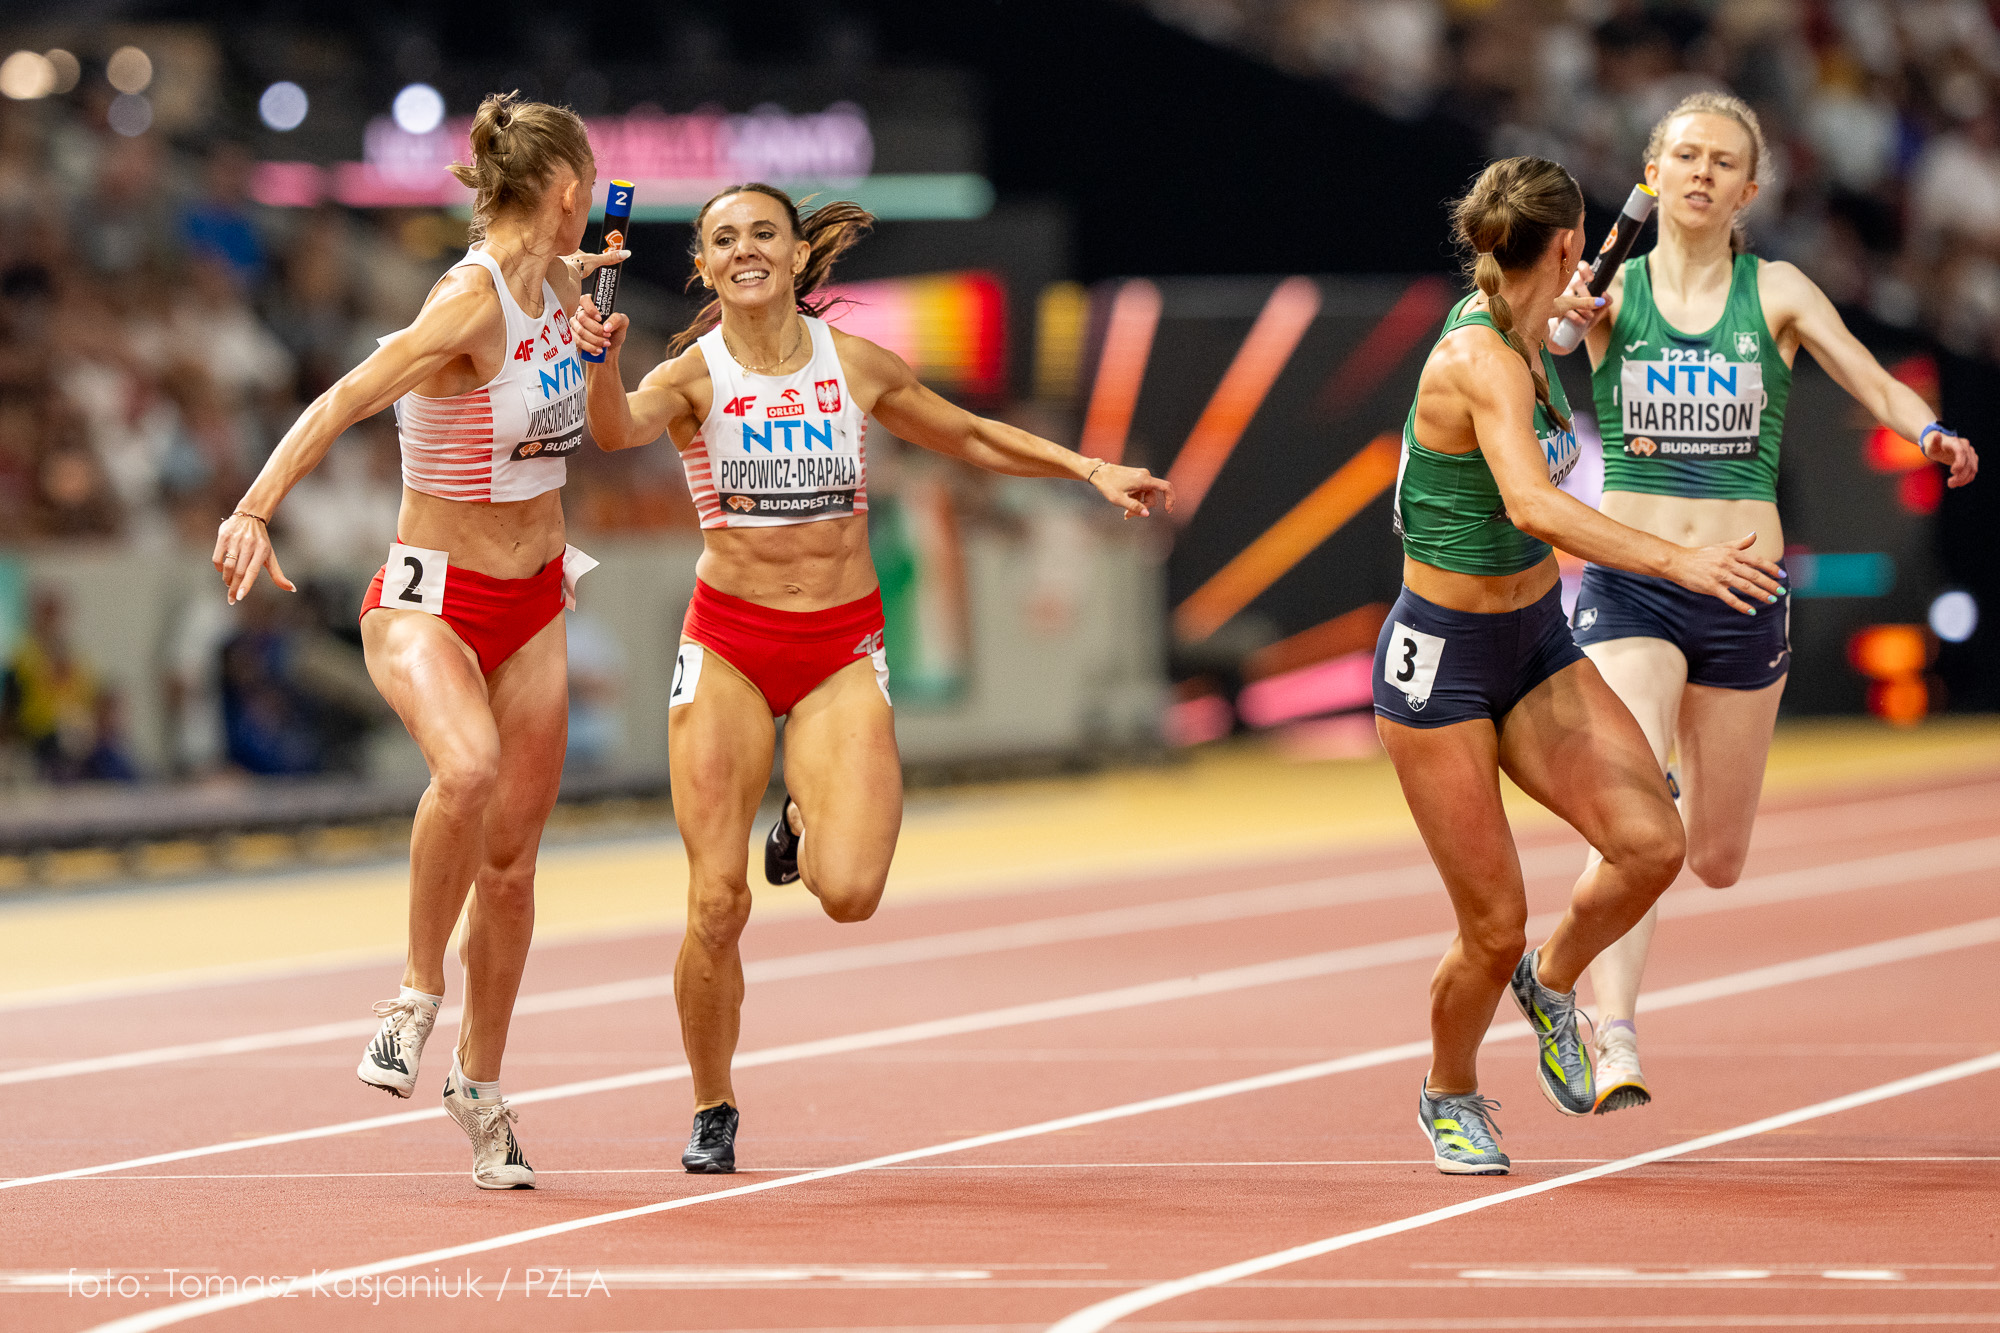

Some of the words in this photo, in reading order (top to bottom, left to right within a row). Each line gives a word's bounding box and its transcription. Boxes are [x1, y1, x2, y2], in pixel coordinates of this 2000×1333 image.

[615, 191, 628, 206] 2
[596, 267, 607, 306] BUDAPEST
[610, 268, 618, 288] WORLD
[605, 288, 614, 316] ATHLETICS
[514, 338, 535, 362] 4F
[543, 345, 559, 362] ORLEN
[539, 351, 583, 401] NTN
[1647, 364, 1737, 397] NTN
[723, 395, 757, 417] 4F
[768, 405, 803, 417] ORLEN
[1629, 401, 1754, 433] HARRISON
[742, 419, 833, 454] NTN
[1661, 440, 1736, 456] BUDAPEST
[1737, 440, 1752, 455] 23
[721, 456, 856, 490] POPOWICZ-DRAPAŁA
[760, 495, 831, 511] BUDAPEST
[398, 556, 424, 604] 2
[853, 628, 884, 655] 4F
[1396, 637, 1418, 682] 3
[672, 654, 685, 698] 2
